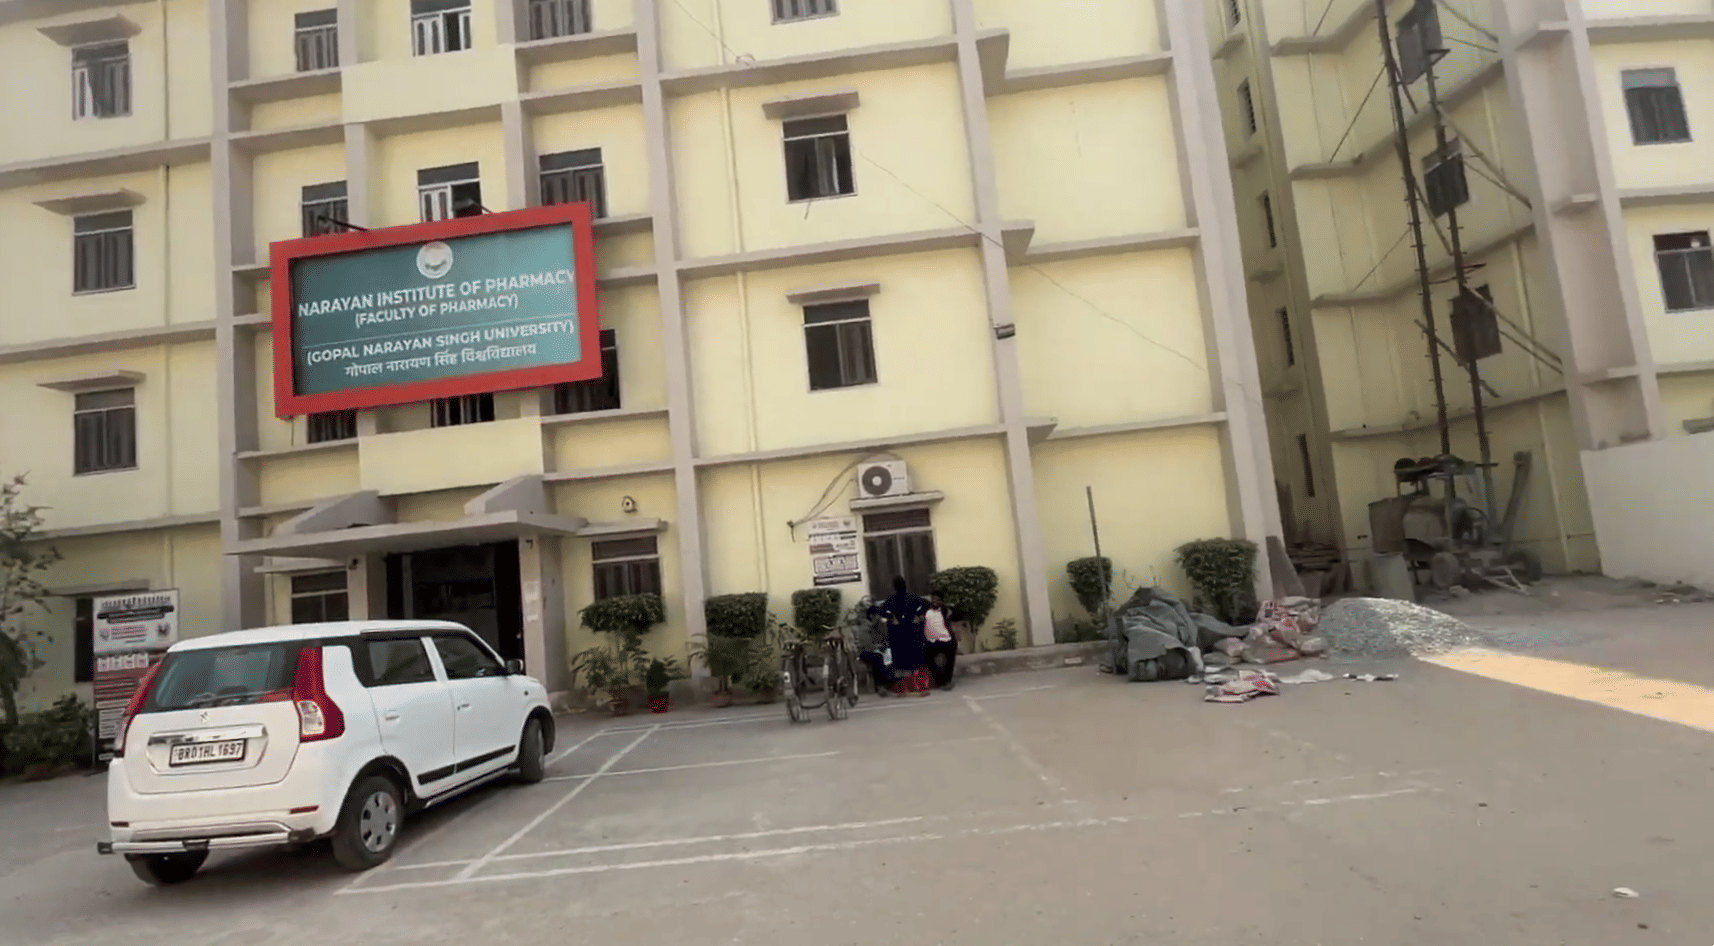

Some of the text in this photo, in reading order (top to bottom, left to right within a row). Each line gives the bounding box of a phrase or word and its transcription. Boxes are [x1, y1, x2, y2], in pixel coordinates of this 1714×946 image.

[298, 269, 574, 317] NARAYAN INSTITUTE OF PHARMACY
[355, 293, 518, 328] (FACULTY OF PHARMACY)
[307, 319, 574, 366] (GOPAL NARAYAN SINGH UNIVERSITY)
[345, 343, 537, 377] गोपाल नारायण सिंह विश्वविद्यालय
